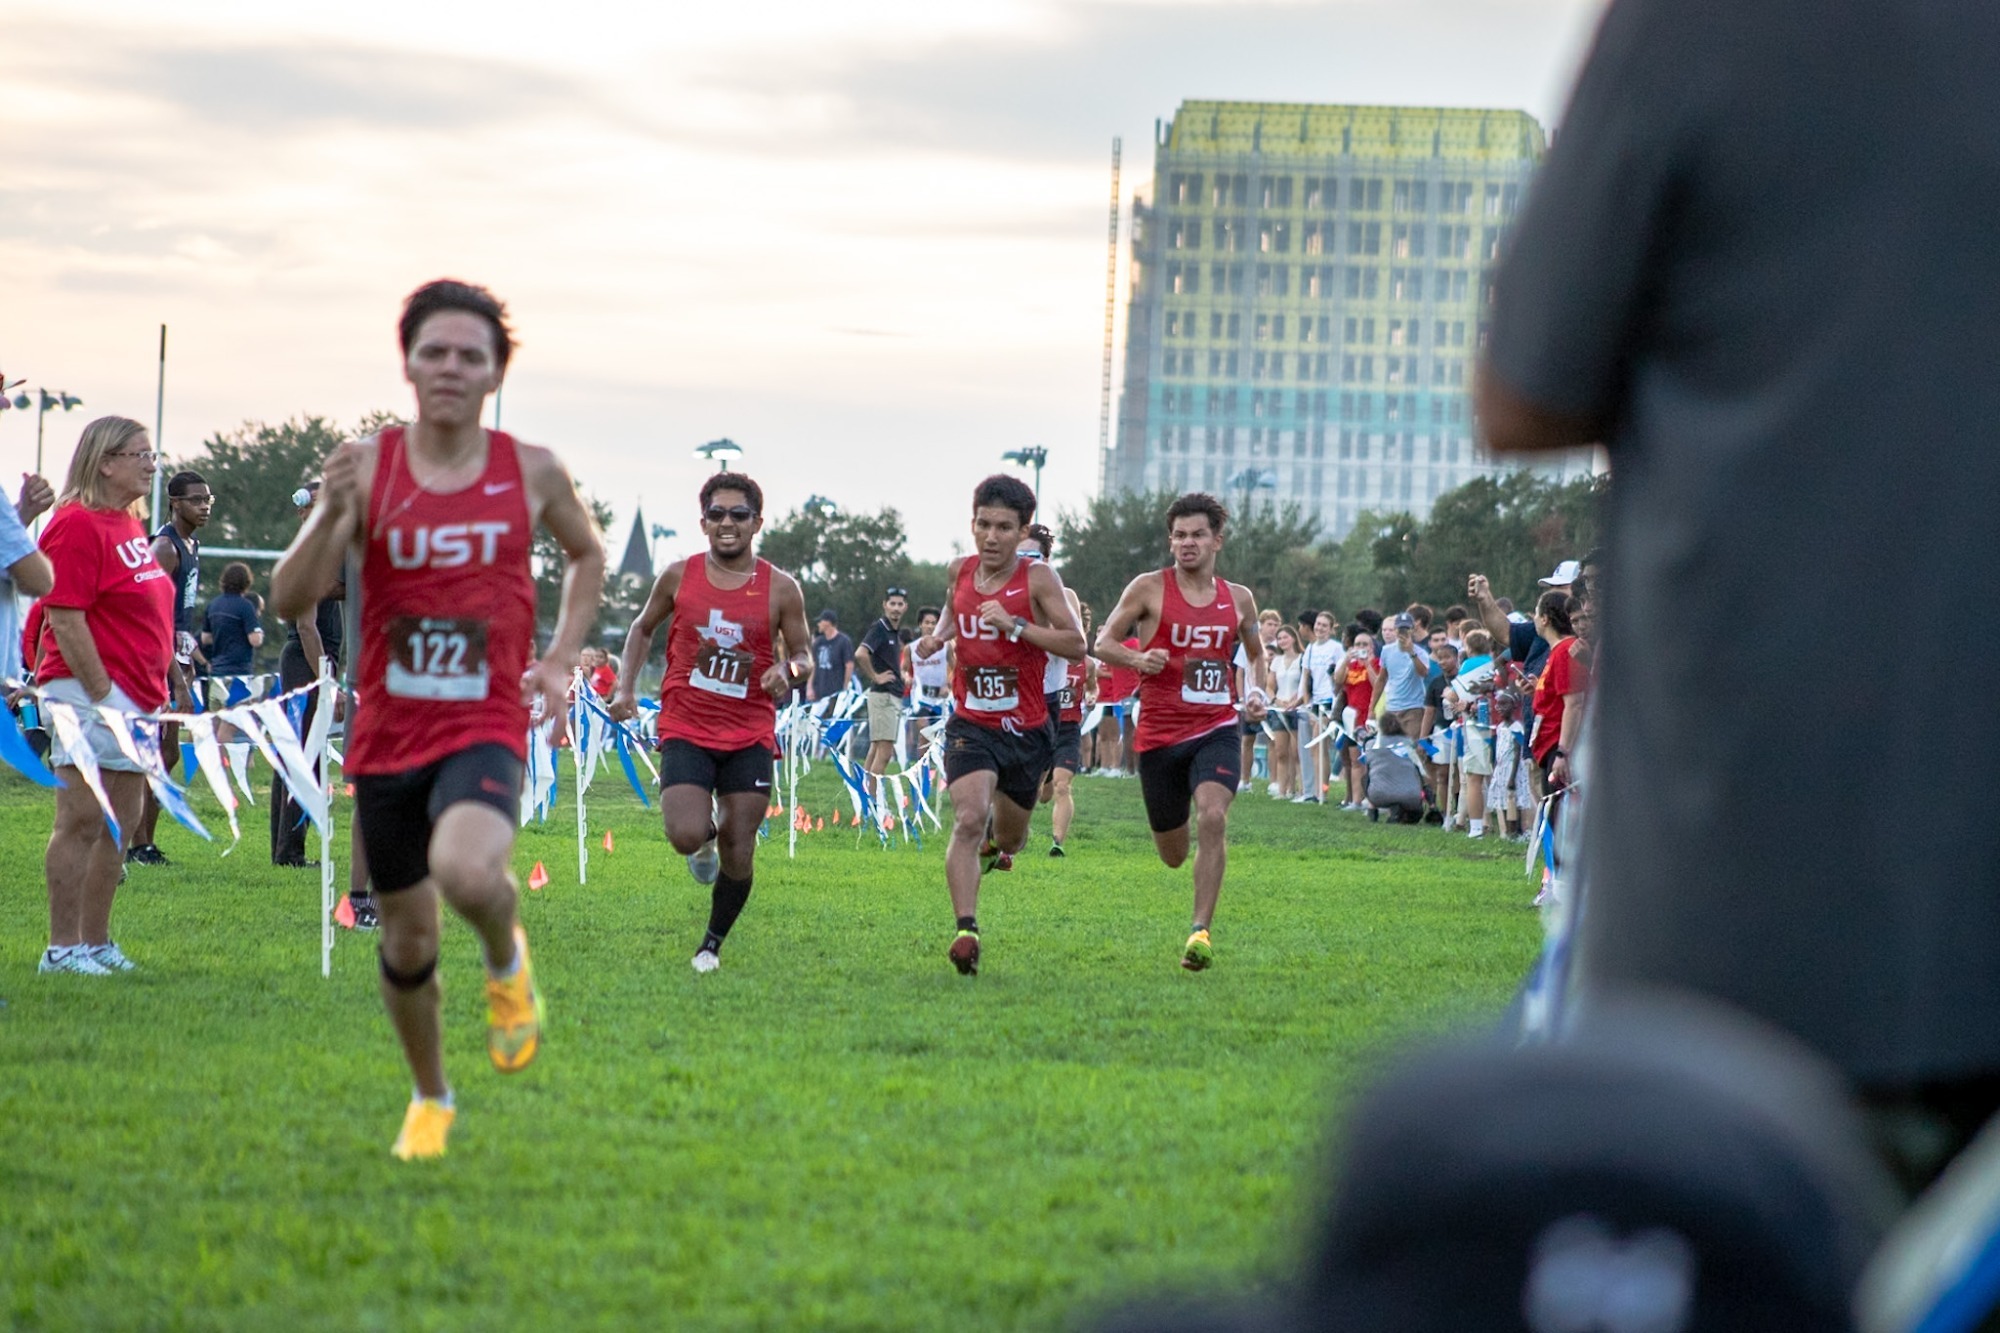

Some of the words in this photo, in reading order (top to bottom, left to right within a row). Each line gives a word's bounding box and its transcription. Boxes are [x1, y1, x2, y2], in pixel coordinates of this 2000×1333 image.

[388, 522, 511, 569] UST
[715, 626, 736, 637] UST
[958, 613, 1014, 640] US
[1171, 623, 1229, 649] UST
[408, 633, 467, 674] 122
[708, 656, 739, 682] 111
[1195, 669, 1221, 691] 137
[974, 676, 1005, 697] 135
